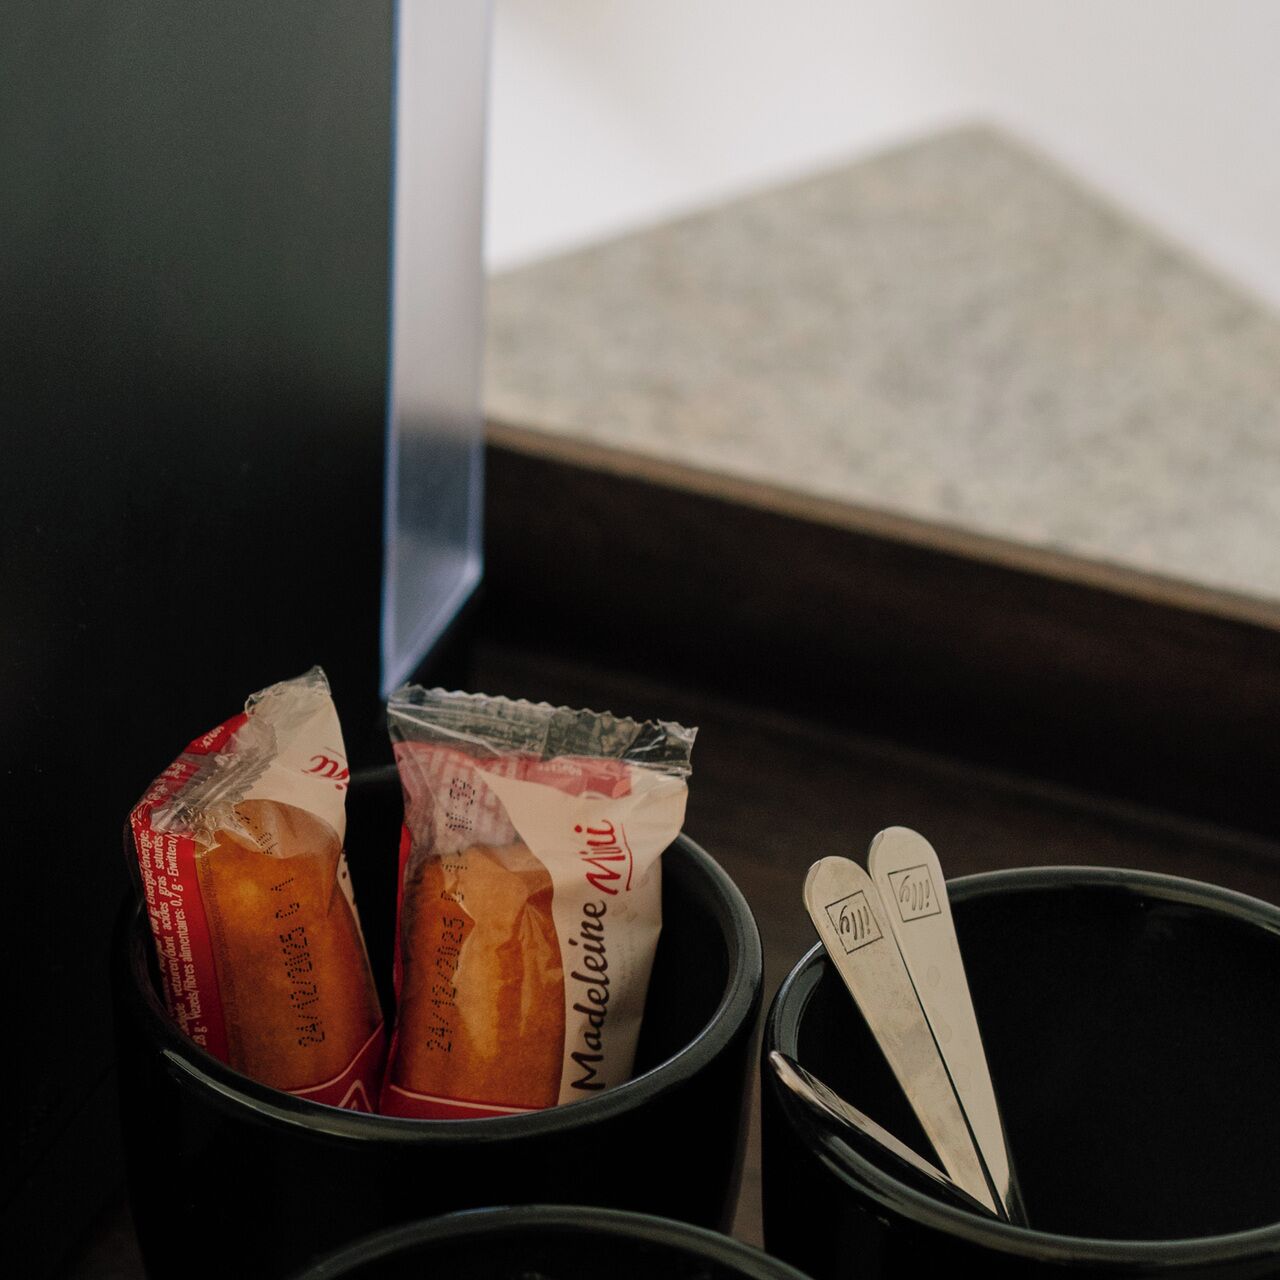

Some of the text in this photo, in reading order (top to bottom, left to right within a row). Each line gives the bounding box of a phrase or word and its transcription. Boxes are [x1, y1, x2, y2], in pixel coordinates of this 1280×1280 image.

[157, 875, 172, 898] gras
[900, 875, 929, 911] illy
[160, 901, 172, 931] acides
[839, 905, 871, 941] illy
[279, 926, 326, 1047] 24/12/2025
[426, 915, 465, 1053] 24/12/2025
[568, 899, 610, 1093] Madeleine
